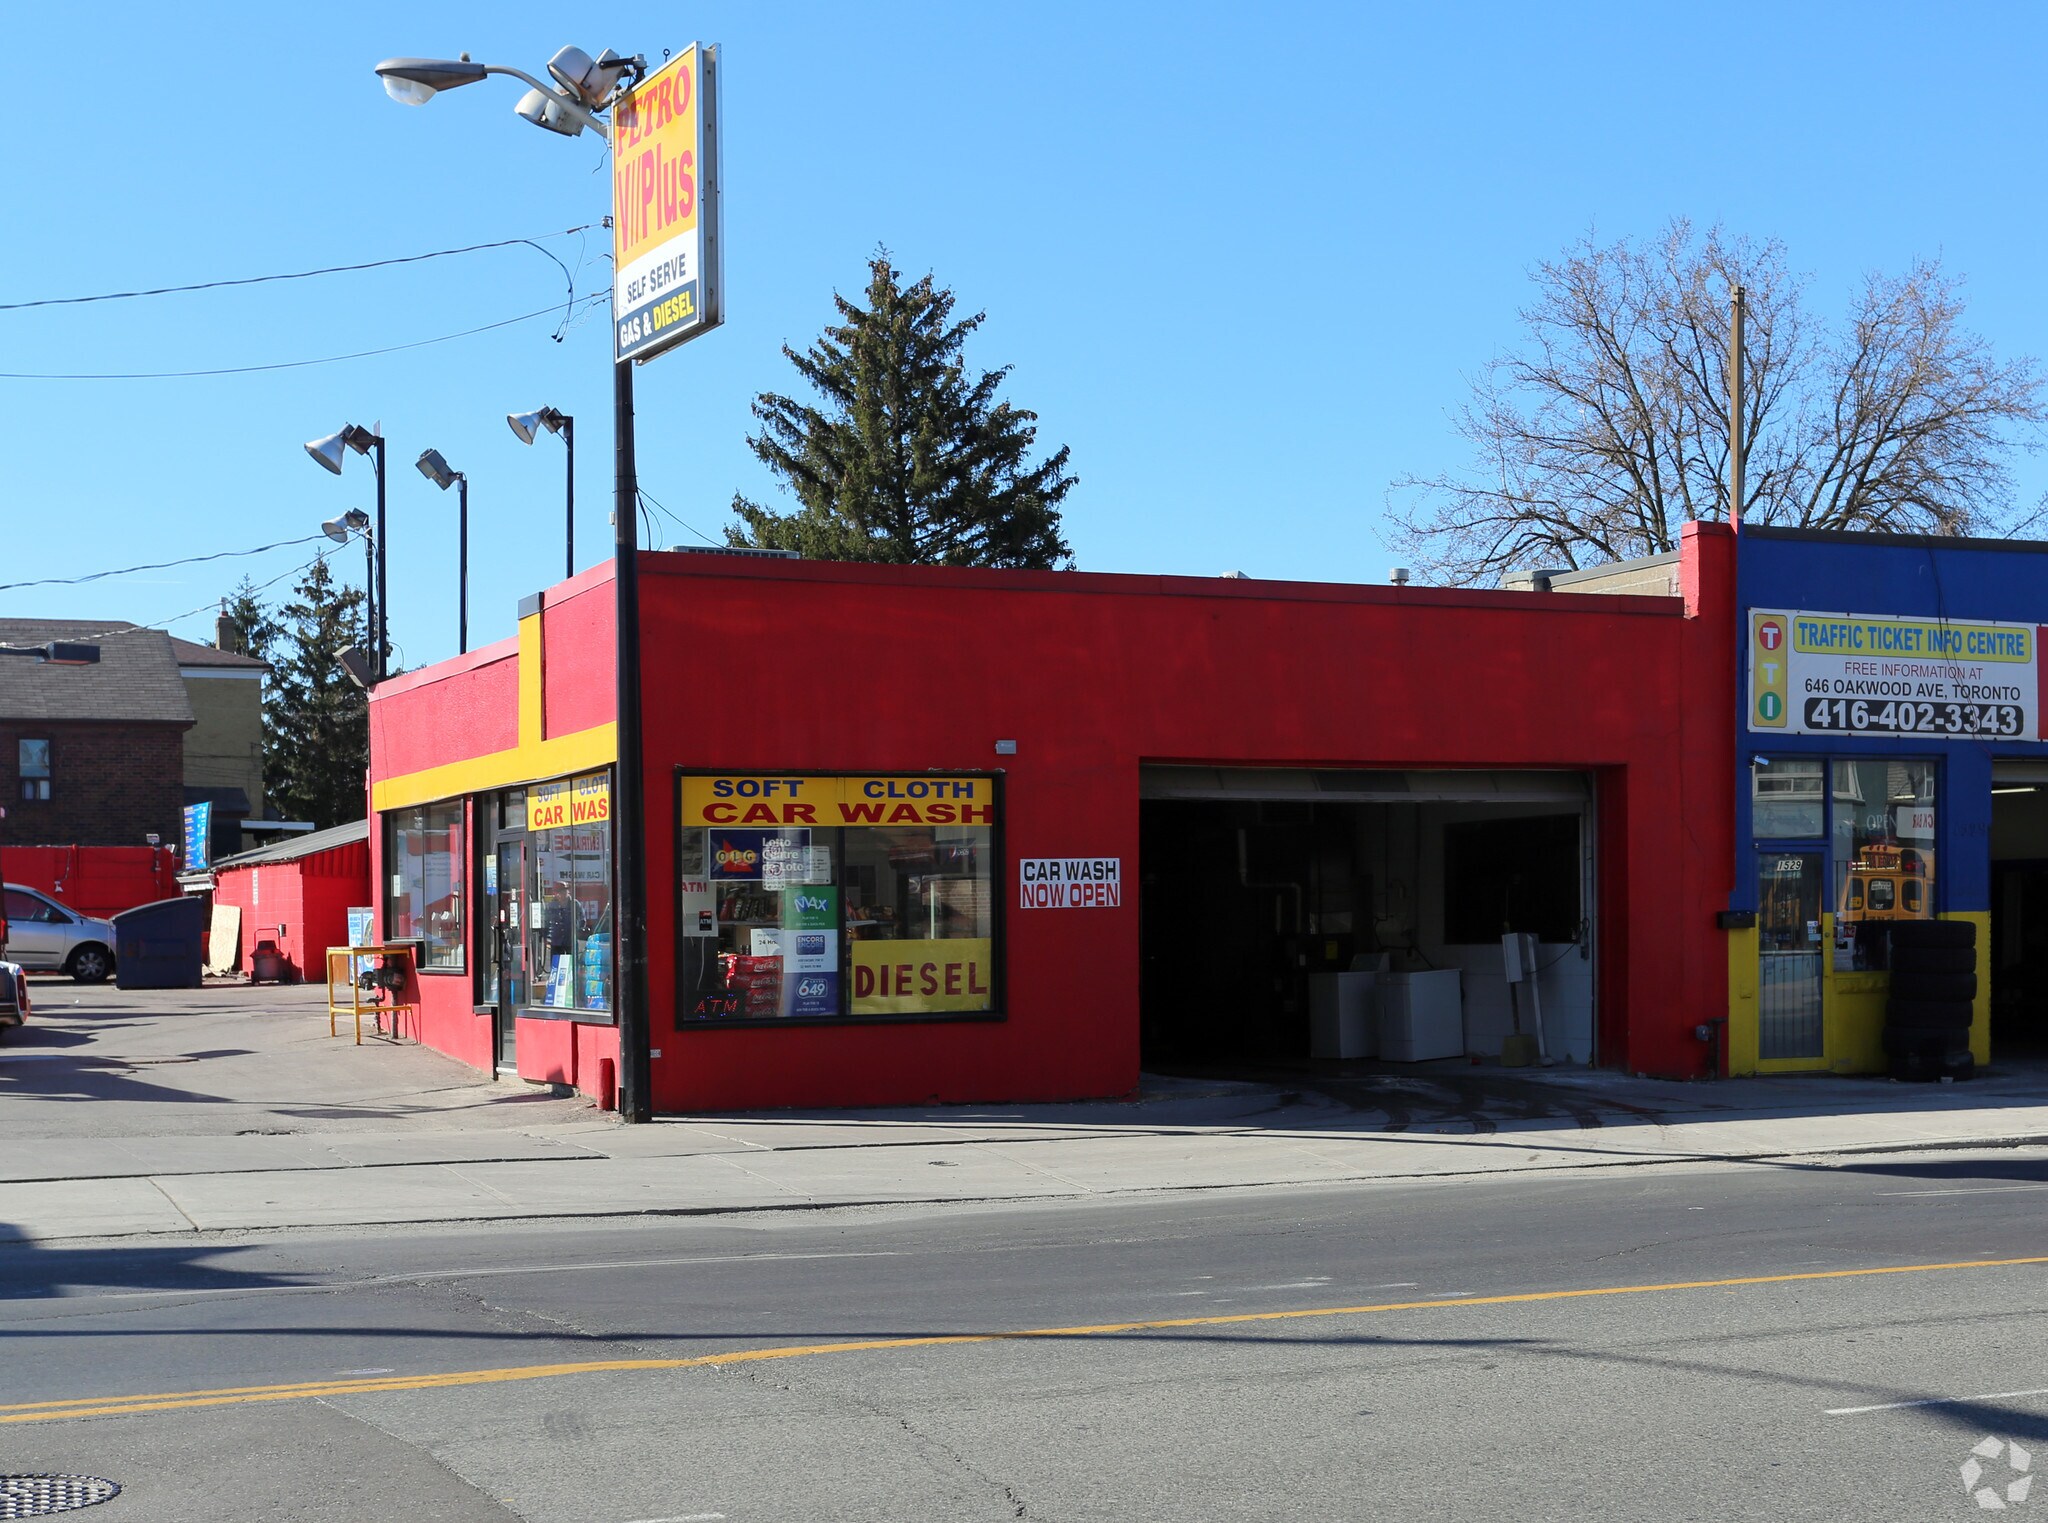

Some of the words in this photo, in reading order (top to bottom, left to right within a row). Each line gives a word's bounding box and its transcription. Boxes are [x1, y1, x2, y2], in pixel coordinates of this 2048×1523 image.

[617, 65, 691, 158] PETRO
[627, 275, 646, 304] SELF
[650, 253, 686, 292] SERVE
[621, 317, 641, 348] GAS
[643, 312, 652, 336] &
[653, 290, 694, 331] DIESEL
[1762, 627, 1778, 648] T
[1798, 622, 1863, 650] TRAFFIC
[1867, 626, 1923, 652] TICKET
[1927, 629, 1962, 654] INFO
[1967, 631, 2025, 656] CENTRE
[1762, 663, 1778, 684] T
[1845, 661, 1877, 676] FREE
[1881, 663, 1966, 680] INFORMATION
[1969, 667, 1983, 680] AT
[1805, 678, 1829, 693] 646
[1834, 679, 1912, 697] OAKWOOD
[1916, 682, 1947, 700] AVE,
[1952, 684, 2020, 700] TORONTO
[1811, 699, 2018, 734] 416-402-3343
[537, 783, 561, 803] SOFT
[712, 779, 804, 798] SOFT
[863, 780, 974, 798] CLOTH
[534, 805, 564, 827] CAR
[702, 803, 818, 823] CAR
[837, 803, 992, 824] WASH
[1023, 861, 1060, 881] CAR
[1065, 861, 1116, 880] WASH
[1779, 860, 1801, 871] 1529
[682, 881, 707, 893] ATM
[1022, 883, 1065, 907] NOW
[1069, 883, 1118, 907] OPEN
[794, 895, 827, 913] MAX
[855, 961, 987, 998] DIESEL
[694, 999, 738, 1013] ATM
